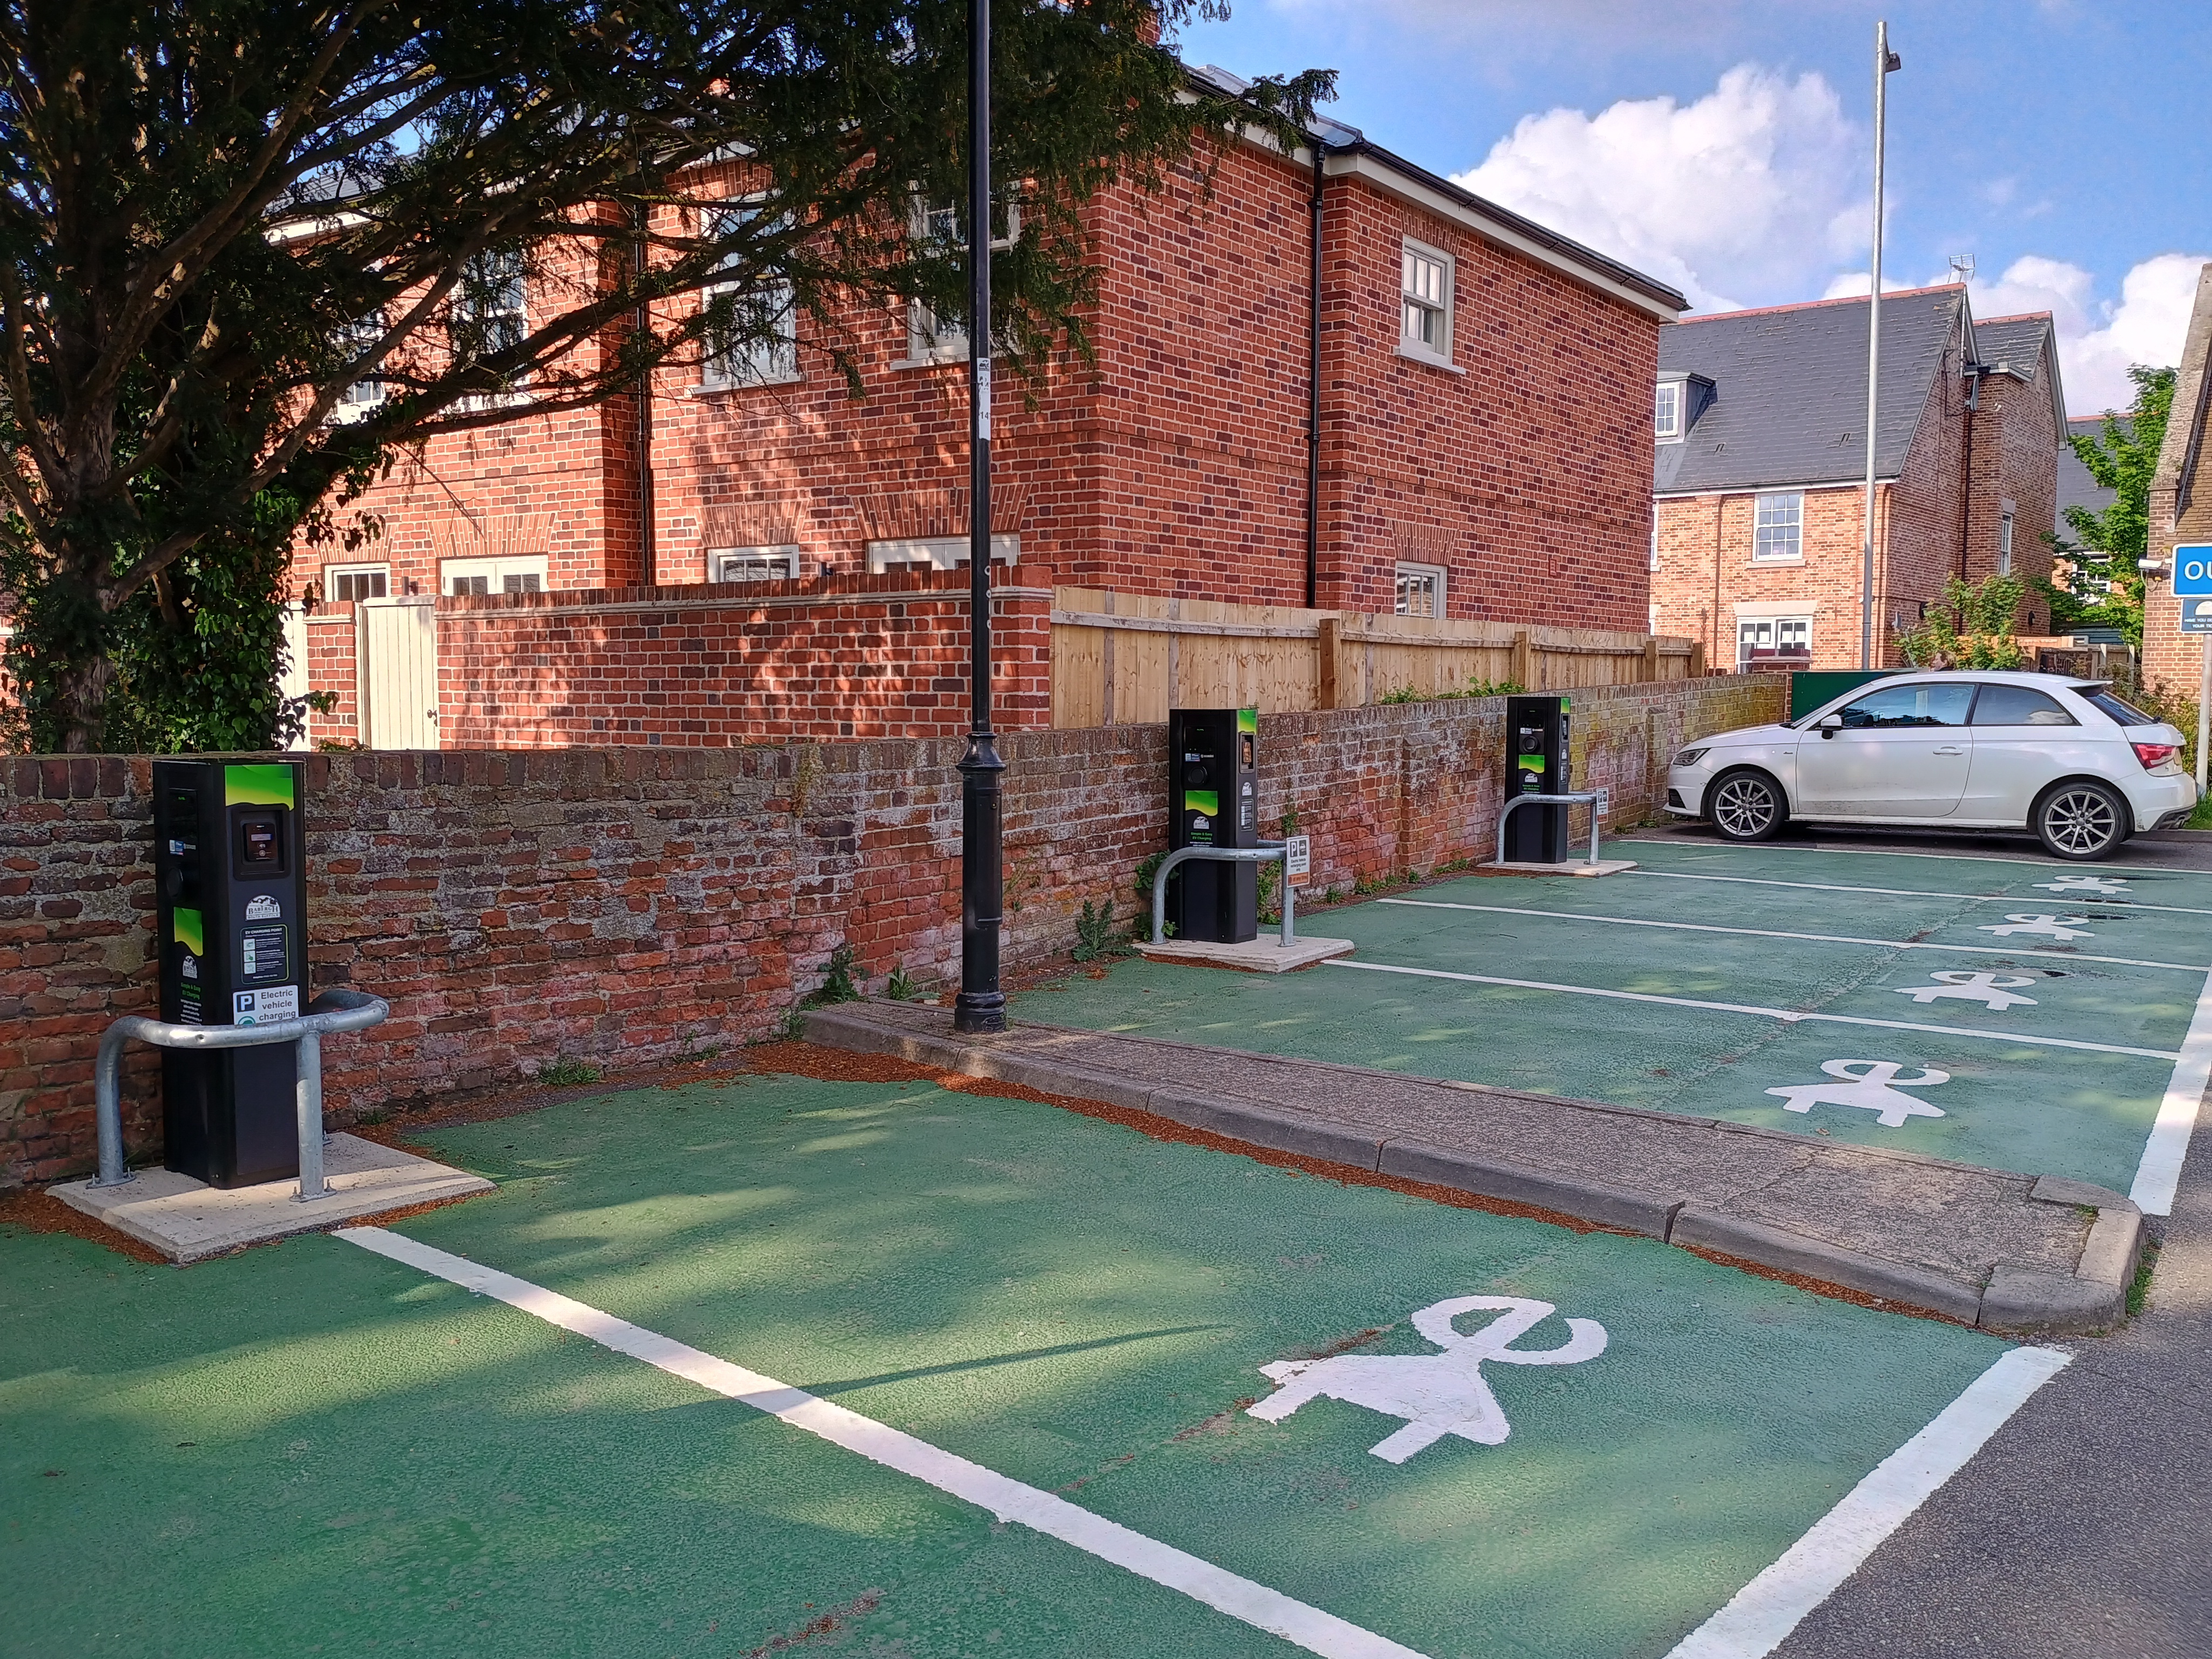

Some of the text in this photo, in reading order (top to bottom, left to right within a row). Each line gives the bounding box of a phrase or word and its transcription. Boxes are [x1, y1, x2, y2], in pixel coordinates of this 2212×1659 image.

[1291, 842, 1297, 857] P
[248, 906, 278, 914] BABERGH
[240, 989, 293, 1011] P Electric
[262, 1000, 292, 1010] vehicle
[259, 1011, 296, 1021] charging
